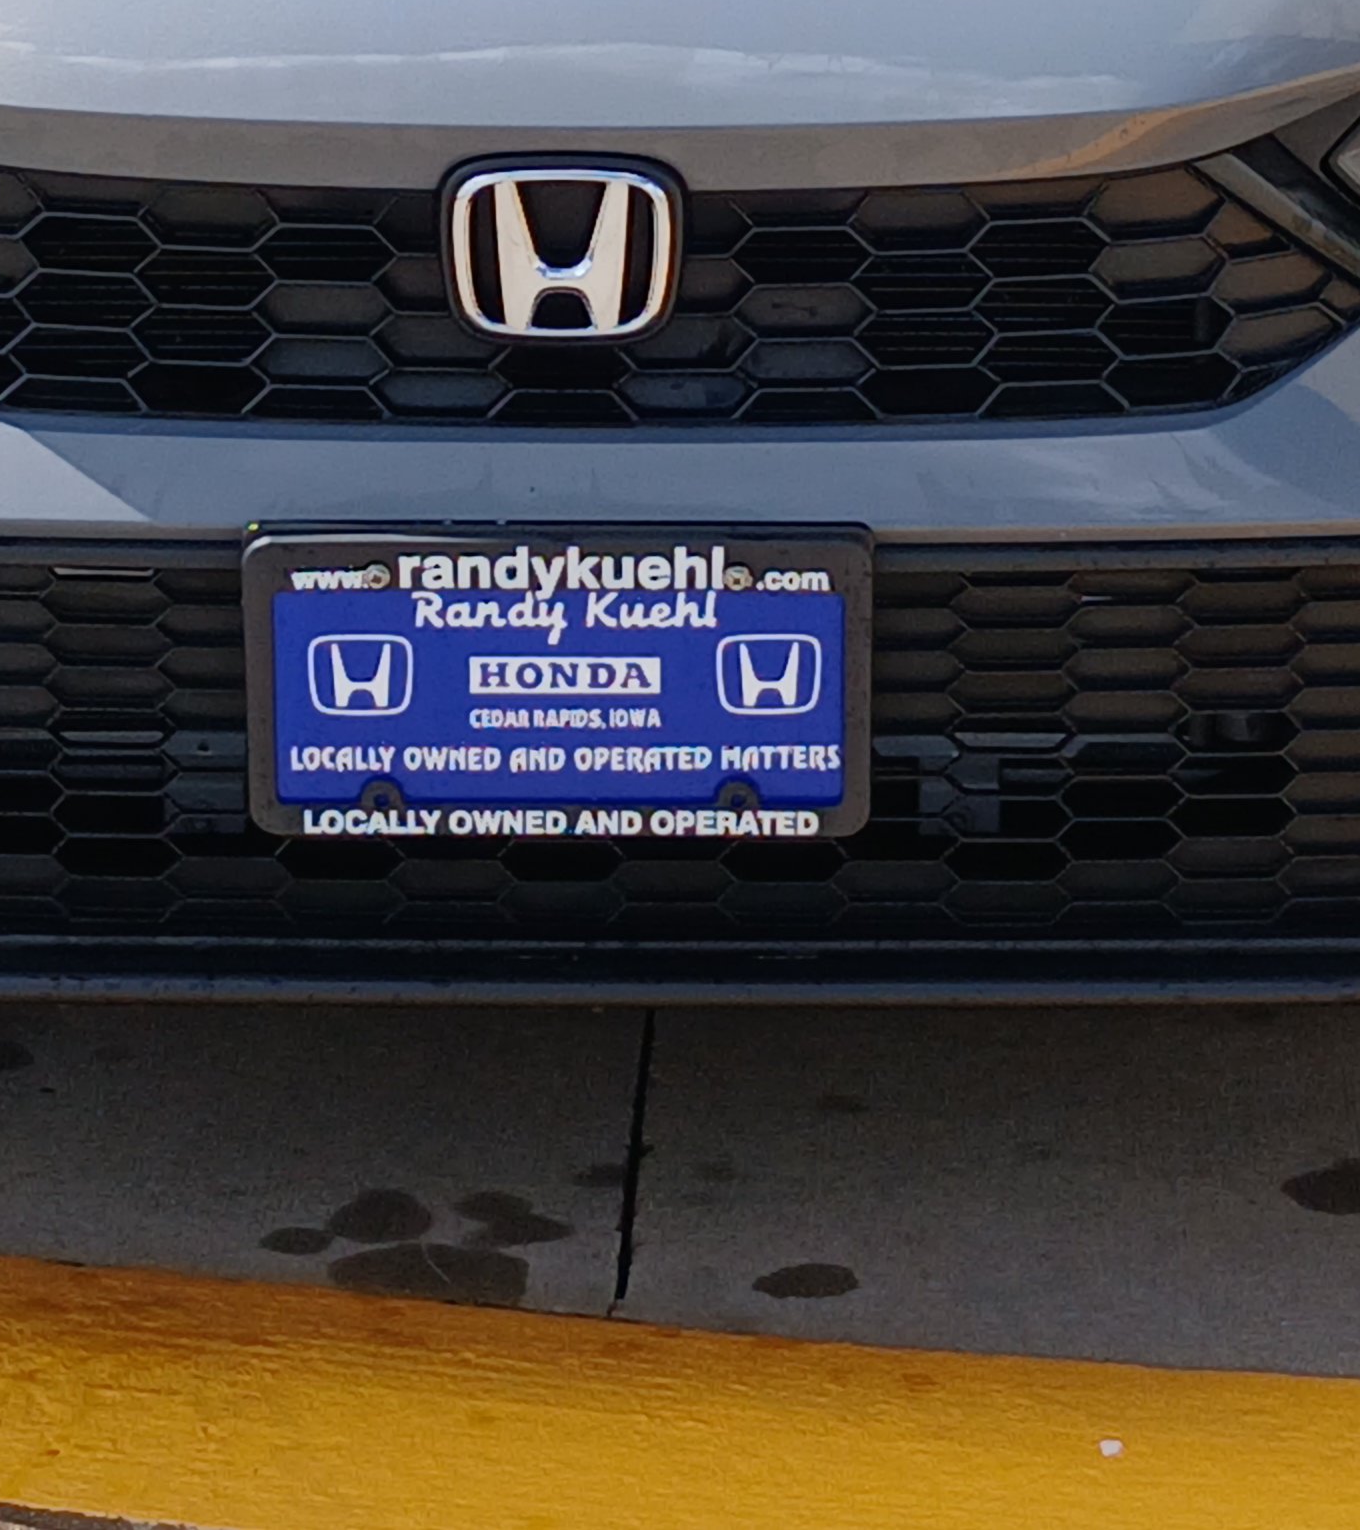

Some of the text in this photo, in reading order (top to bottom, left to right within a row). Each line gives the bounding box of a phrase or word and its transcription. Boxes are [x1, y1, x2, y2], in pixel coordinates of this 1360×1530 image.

[398, 545, 725, 600] randykuehl
[411, 589, 717, 646] Randy Kuehl
[479, 662, 650, 690] HONDA
[469, 707, 662, 731] CEDAR RAPIDS, IOWA
[290, 744, 841, 773] LOCALLY OWNED AND OPERATED MATTERS
[303, 809, 820, 837] LOCALLY OWNED AND OPERATED
